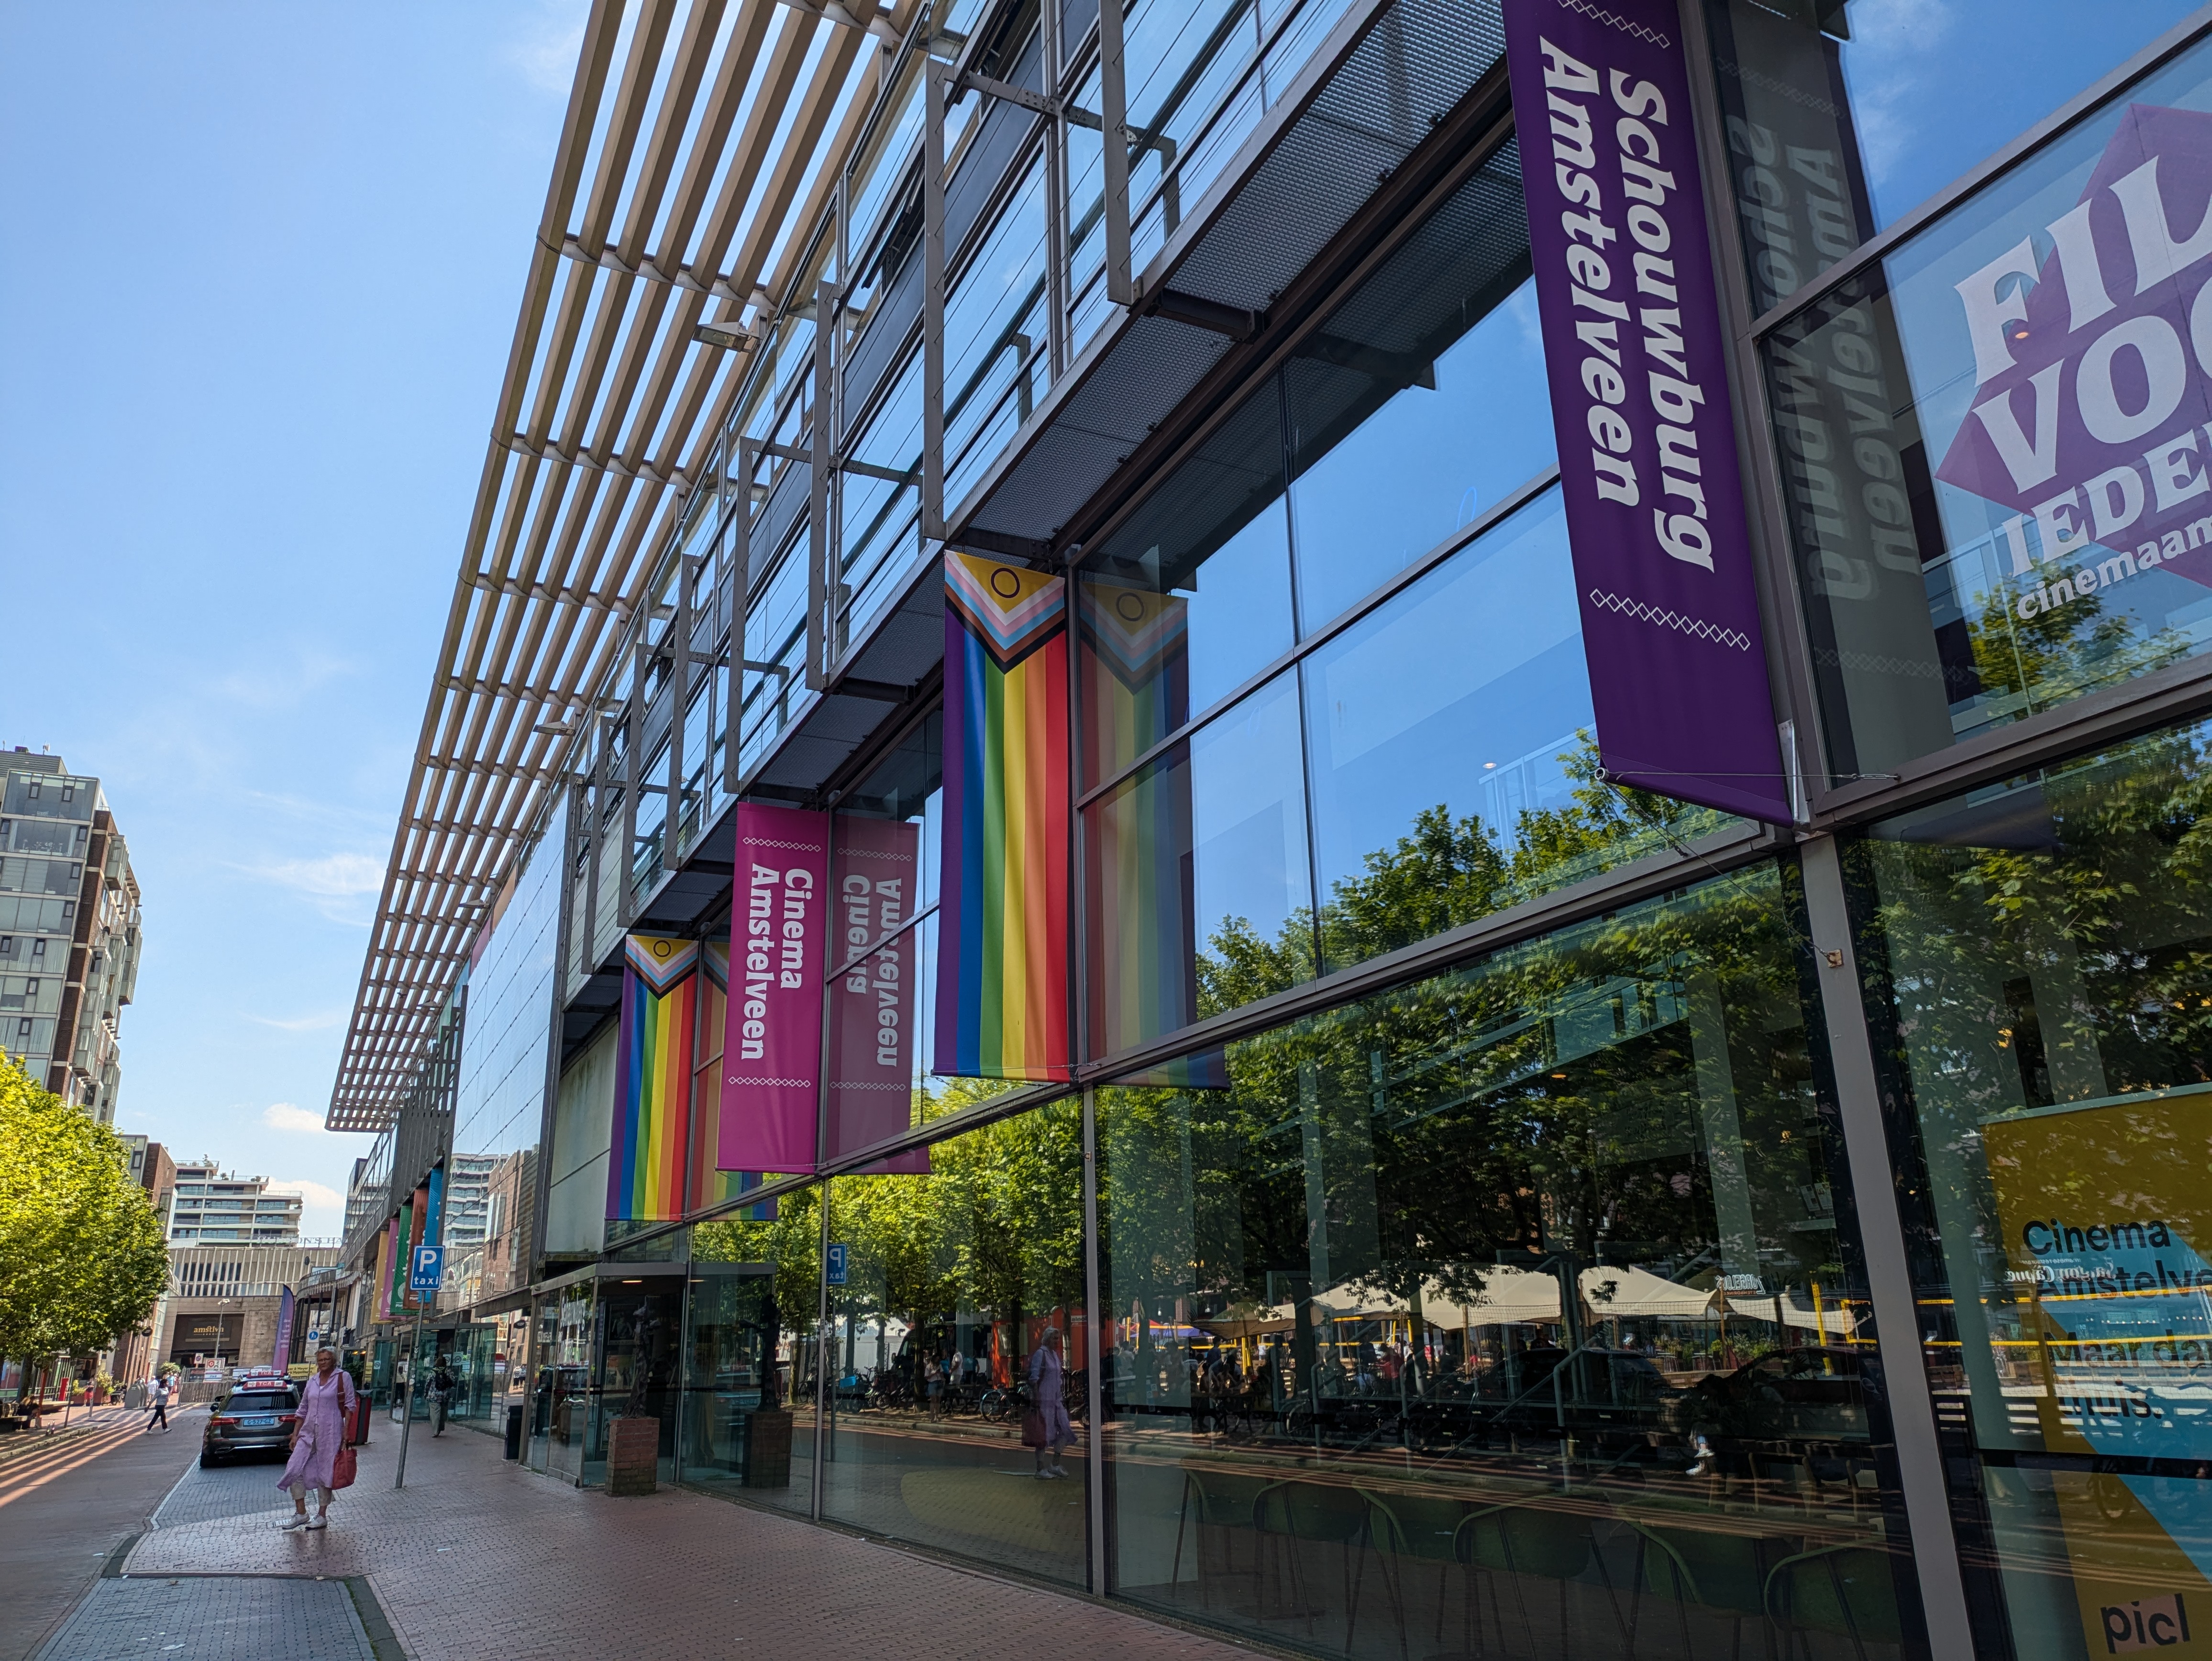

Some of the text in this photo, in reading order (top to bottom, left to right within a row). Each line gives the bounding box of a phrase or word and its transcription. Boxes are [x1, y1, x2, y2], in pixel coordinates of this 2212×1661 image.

[1539, 34, 1641, 508] Amstelveen
[1609, 67, 1715, 574] Schouwburg
[2002, 421, 2212, 578] IEDE
[741, 863, 780, 1060] Amstelveen
[780, 867, 814, 990] Cinema
[414, 1276, 439, 1285] taxi
[419, 1250, 437, 1273] P
[2022, 1218, 2171, 1256] Cinema
[2043, 1329, 2212, 1369] Maar da
[2100, 1593, 2190, 1654] picl
